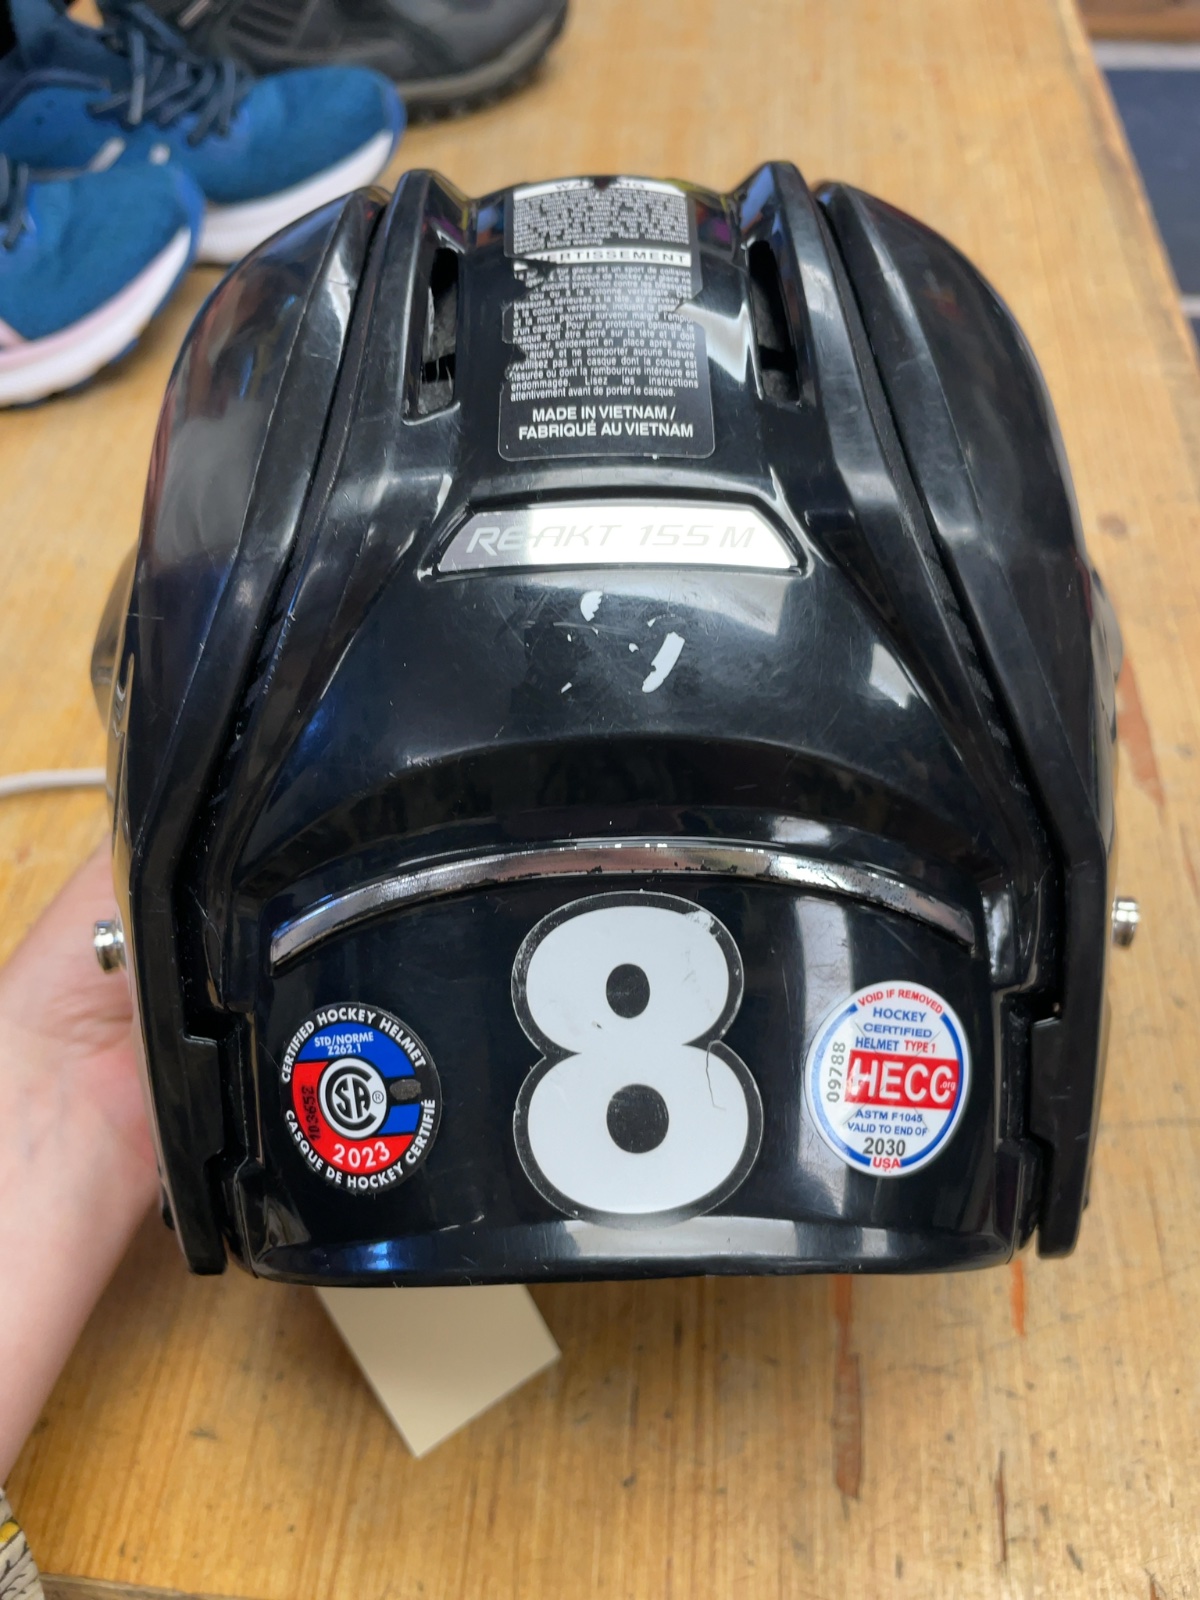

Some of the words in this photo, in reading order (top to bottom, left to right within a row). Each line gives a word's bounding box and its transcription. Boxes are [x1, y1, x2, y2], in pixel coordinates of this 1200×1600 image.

[568, 386, 590, 398] avant
[593, 385, 604, 396] de
[606, 386, 632, 398] porter
[532, 406, 577, 422] MADE
[581, 406, 596, 420] IN
[599, 405, 668, 420] VIETNAM
[518, 420, 597, 440] FABRIQUÉ
[601, 422, 622, 436] AU
[625, 422, 694, 438] VIETNAM
[858, 990, 884, 1007] VOID
[886, 989, 895, 998] IF
[897, 989, 944, 1014] REMOVED
[872, 1007, 927, 1023] HOCKEY
[863, 1022, 932, 1038] CERTIFIED
[282, 1022, 316, 1083] CERTIFIED
[316, 1007, 377, 1026] HOCKEY
[379, 1018, 426, 1068] HELMET
[314, 1032, 374, 1047] STD/NORME
[855, 1036, 900, 1052] HELMET
[904, 1040, 929, 1052] TYPE
[932, 1043, 936, 1053] 1
[327, 1044, 362, 1056] Z262.1
[526, 906, 748, 1214] 8
[826, 1041, 846, 1103] 09788
[851, 1057, 952, 1104] HECC
[855, 1110, 888, 1120] ASTM
[847, 1122, 876, 1134] VALID
[878, 1124, 892, 1134] TO
[894, 1126, 912, 1136] END
[914, 1127, 928, 1137] OF
[285, 1110, 324, 1170] CASQUE
[326, 1168, 343, 1184] DE
[347, 1163, 404, 1190] HOCKEY
[405, 1098, 436, 1165] CERTIFIÉ
[862, 1137, 906, 1157] 2030
[332, 1141, 391, 1168] 2023
[872, 1157, 902, 1168] USA
